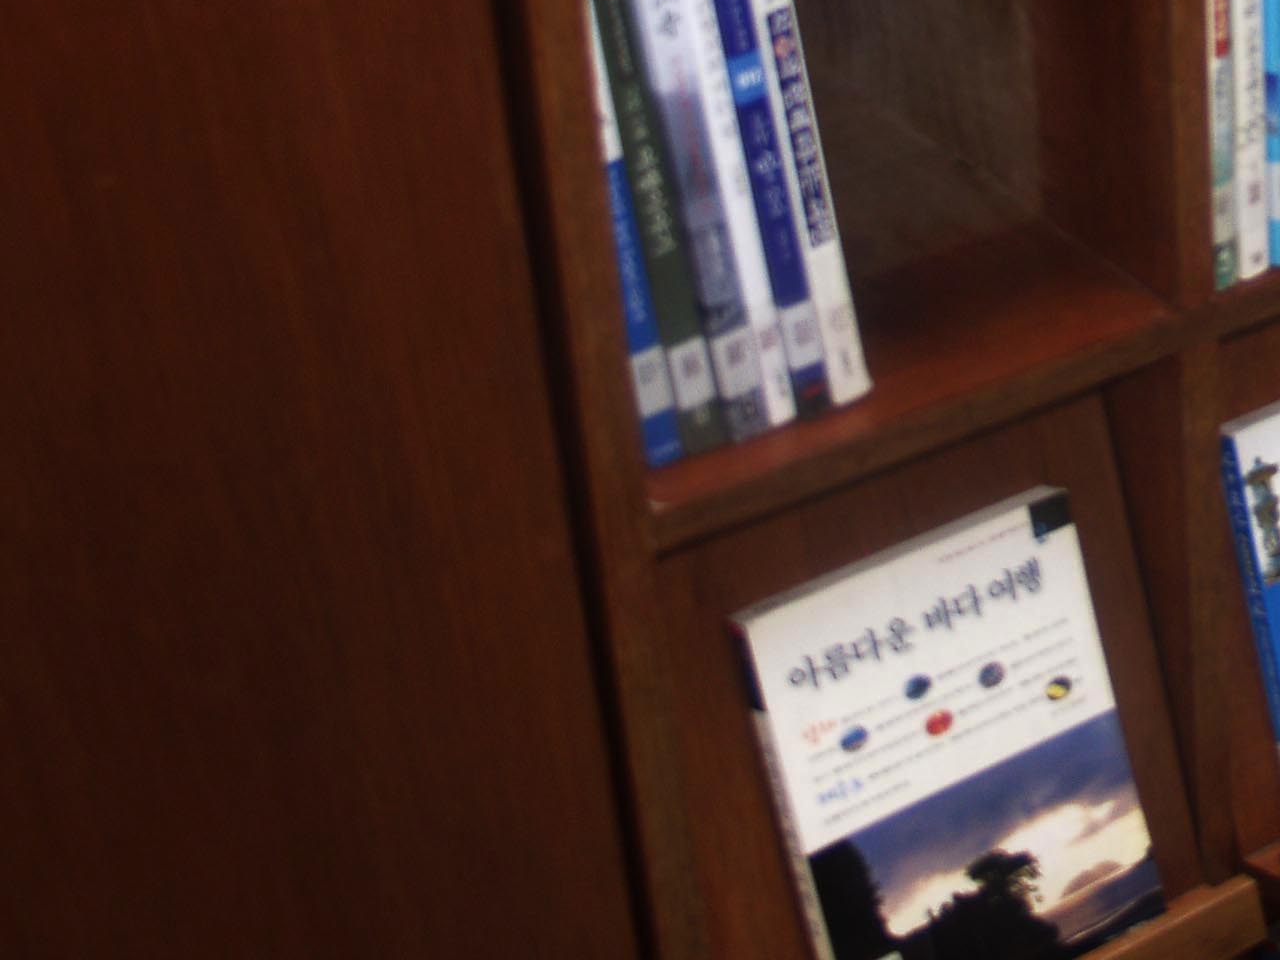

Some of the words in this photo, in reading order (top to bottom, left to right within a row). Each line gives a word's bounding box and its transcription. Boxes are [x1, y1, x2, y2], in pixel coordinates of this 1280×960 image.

[787, 616, 916, 691] 아름다운
[922, 584, 985, 632] 바다
[987, 556, 1043, 602] 여행
